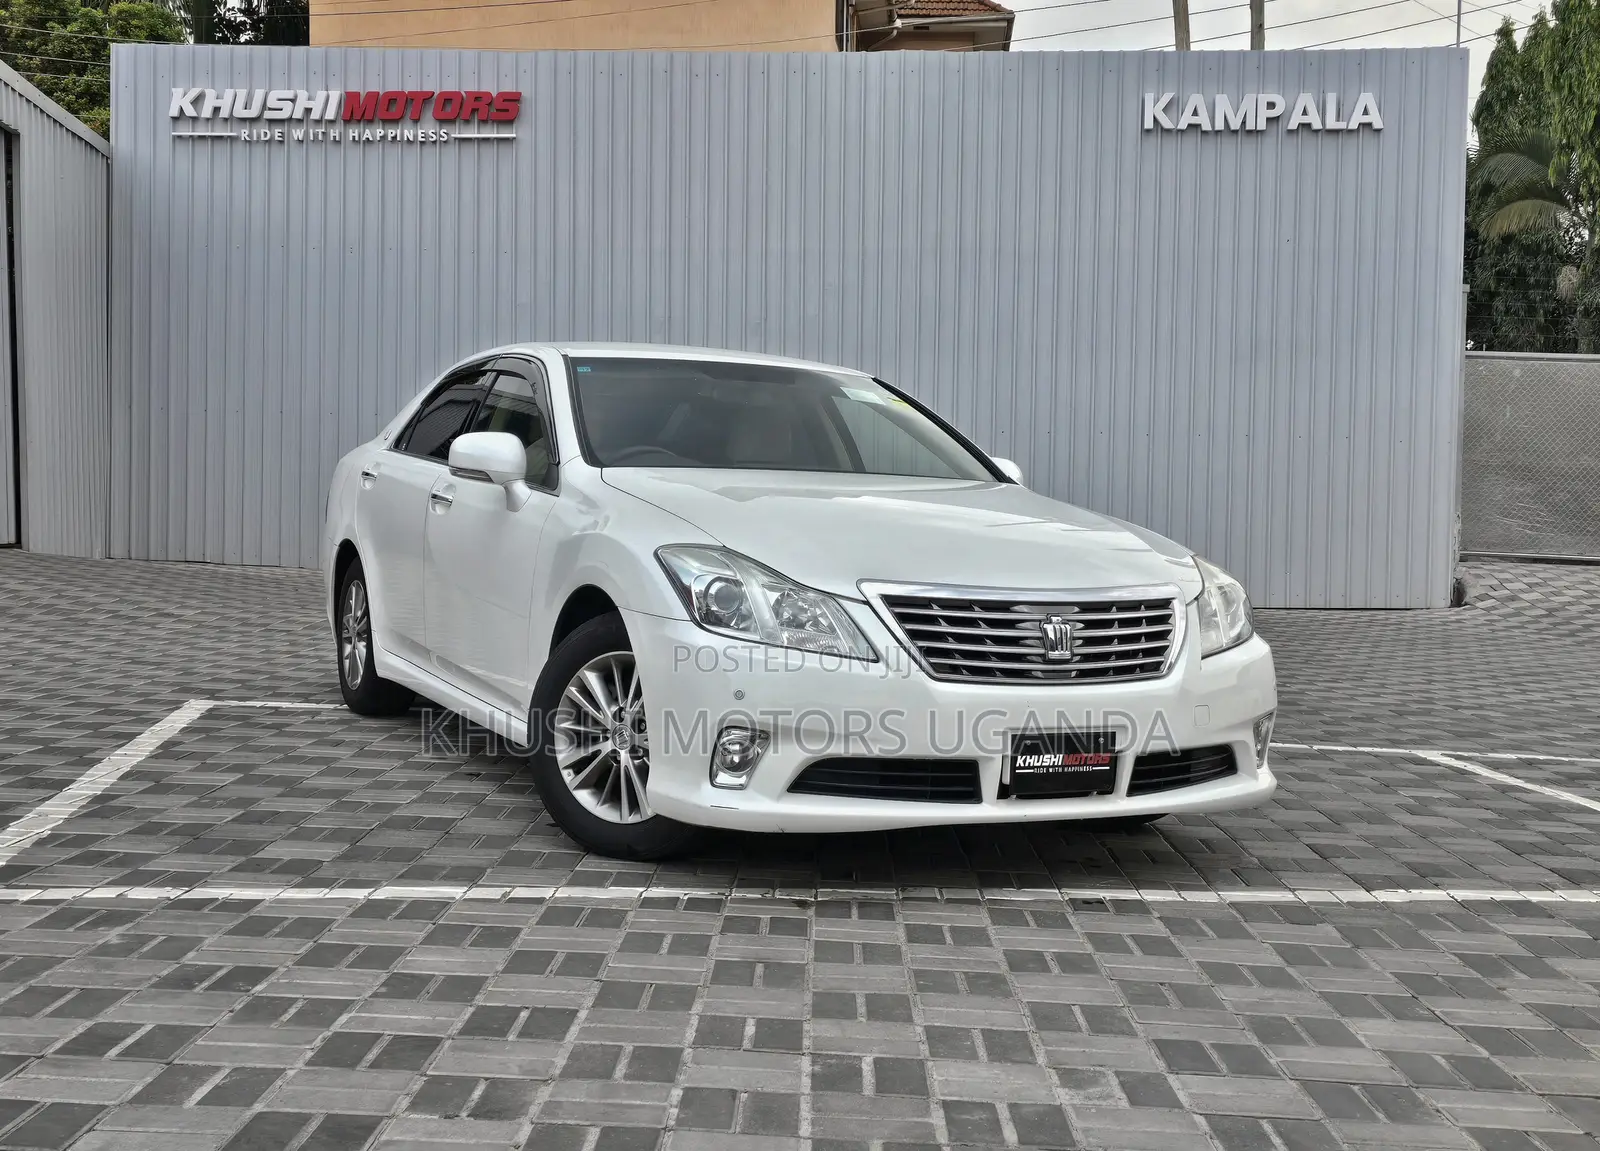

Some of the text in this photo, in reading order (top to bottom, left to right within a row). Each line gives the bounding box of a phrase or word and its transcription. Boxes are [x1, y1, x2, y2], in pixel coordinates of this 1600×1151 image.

[1143, 92, 1385, 132] KAMPALA
[240, 128, 450, 143] RIDE WITH HAPPINESS
